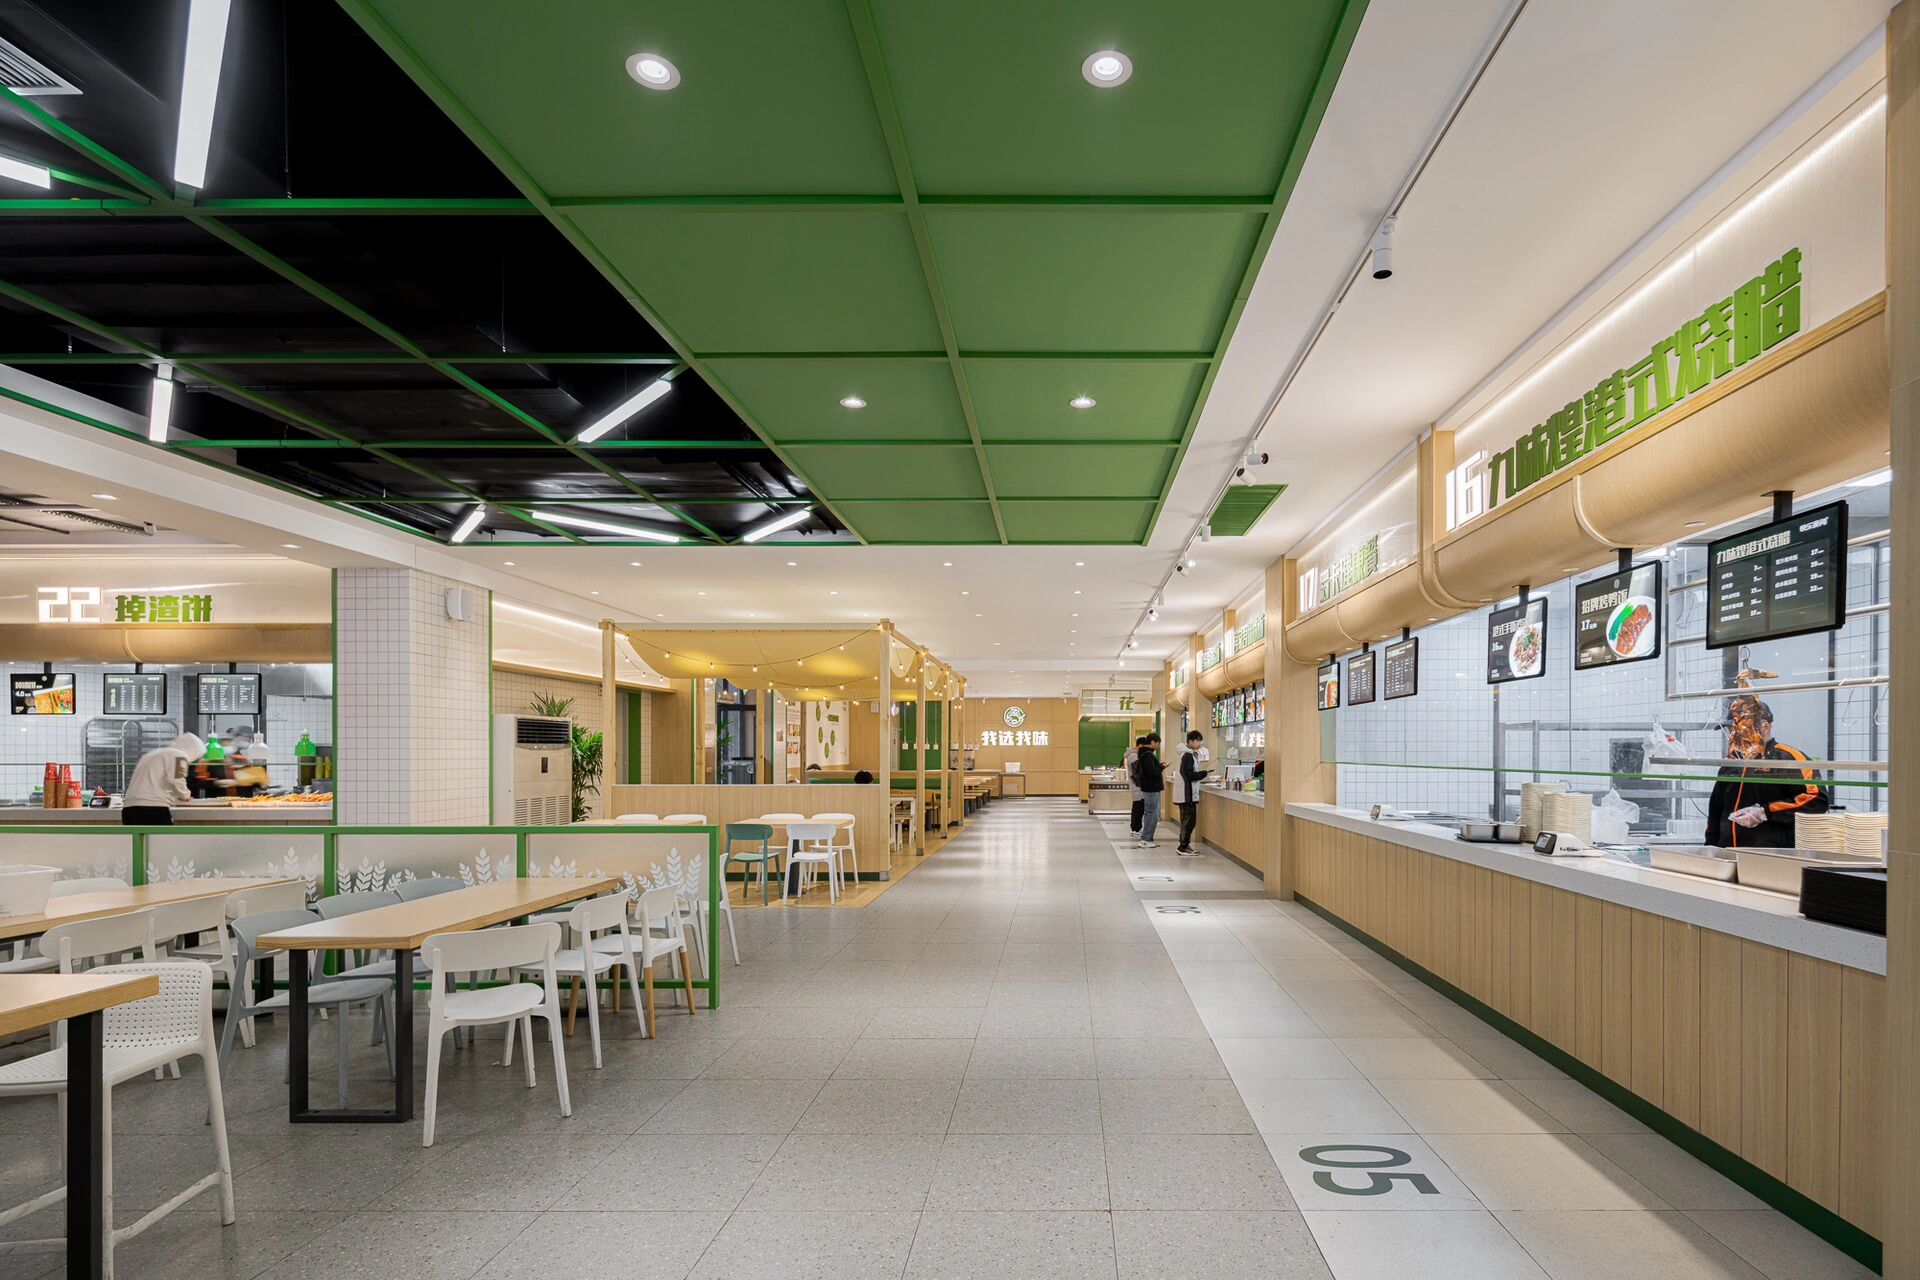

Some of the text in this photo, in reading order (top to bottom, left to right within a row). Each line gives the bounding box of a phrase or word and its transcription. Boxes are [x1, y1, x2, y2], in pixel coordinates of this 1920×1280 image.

[1446, 247, 1802, 532] 16 九味煌港式烧腊
[37, 586, 213, 623] 22 掉渣饼
[1119, 695, 1153, 711] 花一
[981, 730, 1049, 746] 我选我味
[1298, 1144, 1441, 1196] 05
